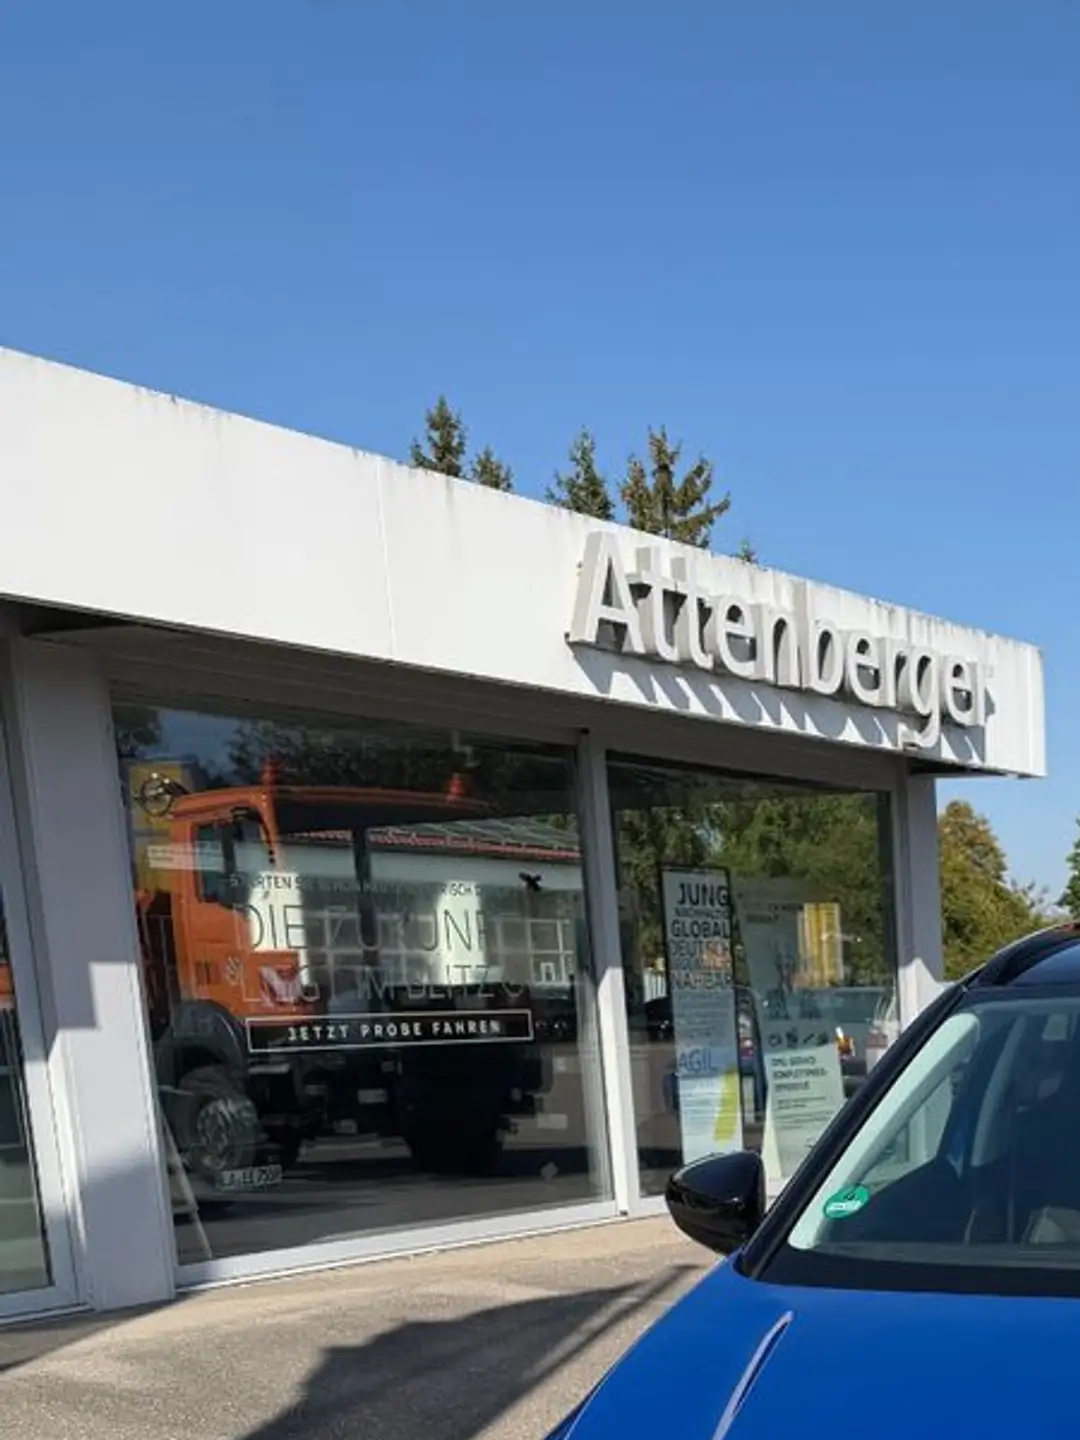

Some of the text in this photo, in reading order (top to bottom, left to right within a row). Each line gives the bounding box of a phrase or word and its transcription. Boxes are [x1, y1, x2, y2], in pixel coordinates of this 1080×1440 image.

[570, 530, 996, 748] Attenberger
[678, 883, 729, 906] JUNG
[233, 903, 306, 950] DIE
[671, 920, 731, 938] GLOBAL
[288, 1019, 500, 1041] JETZT PROBE FAHREN
